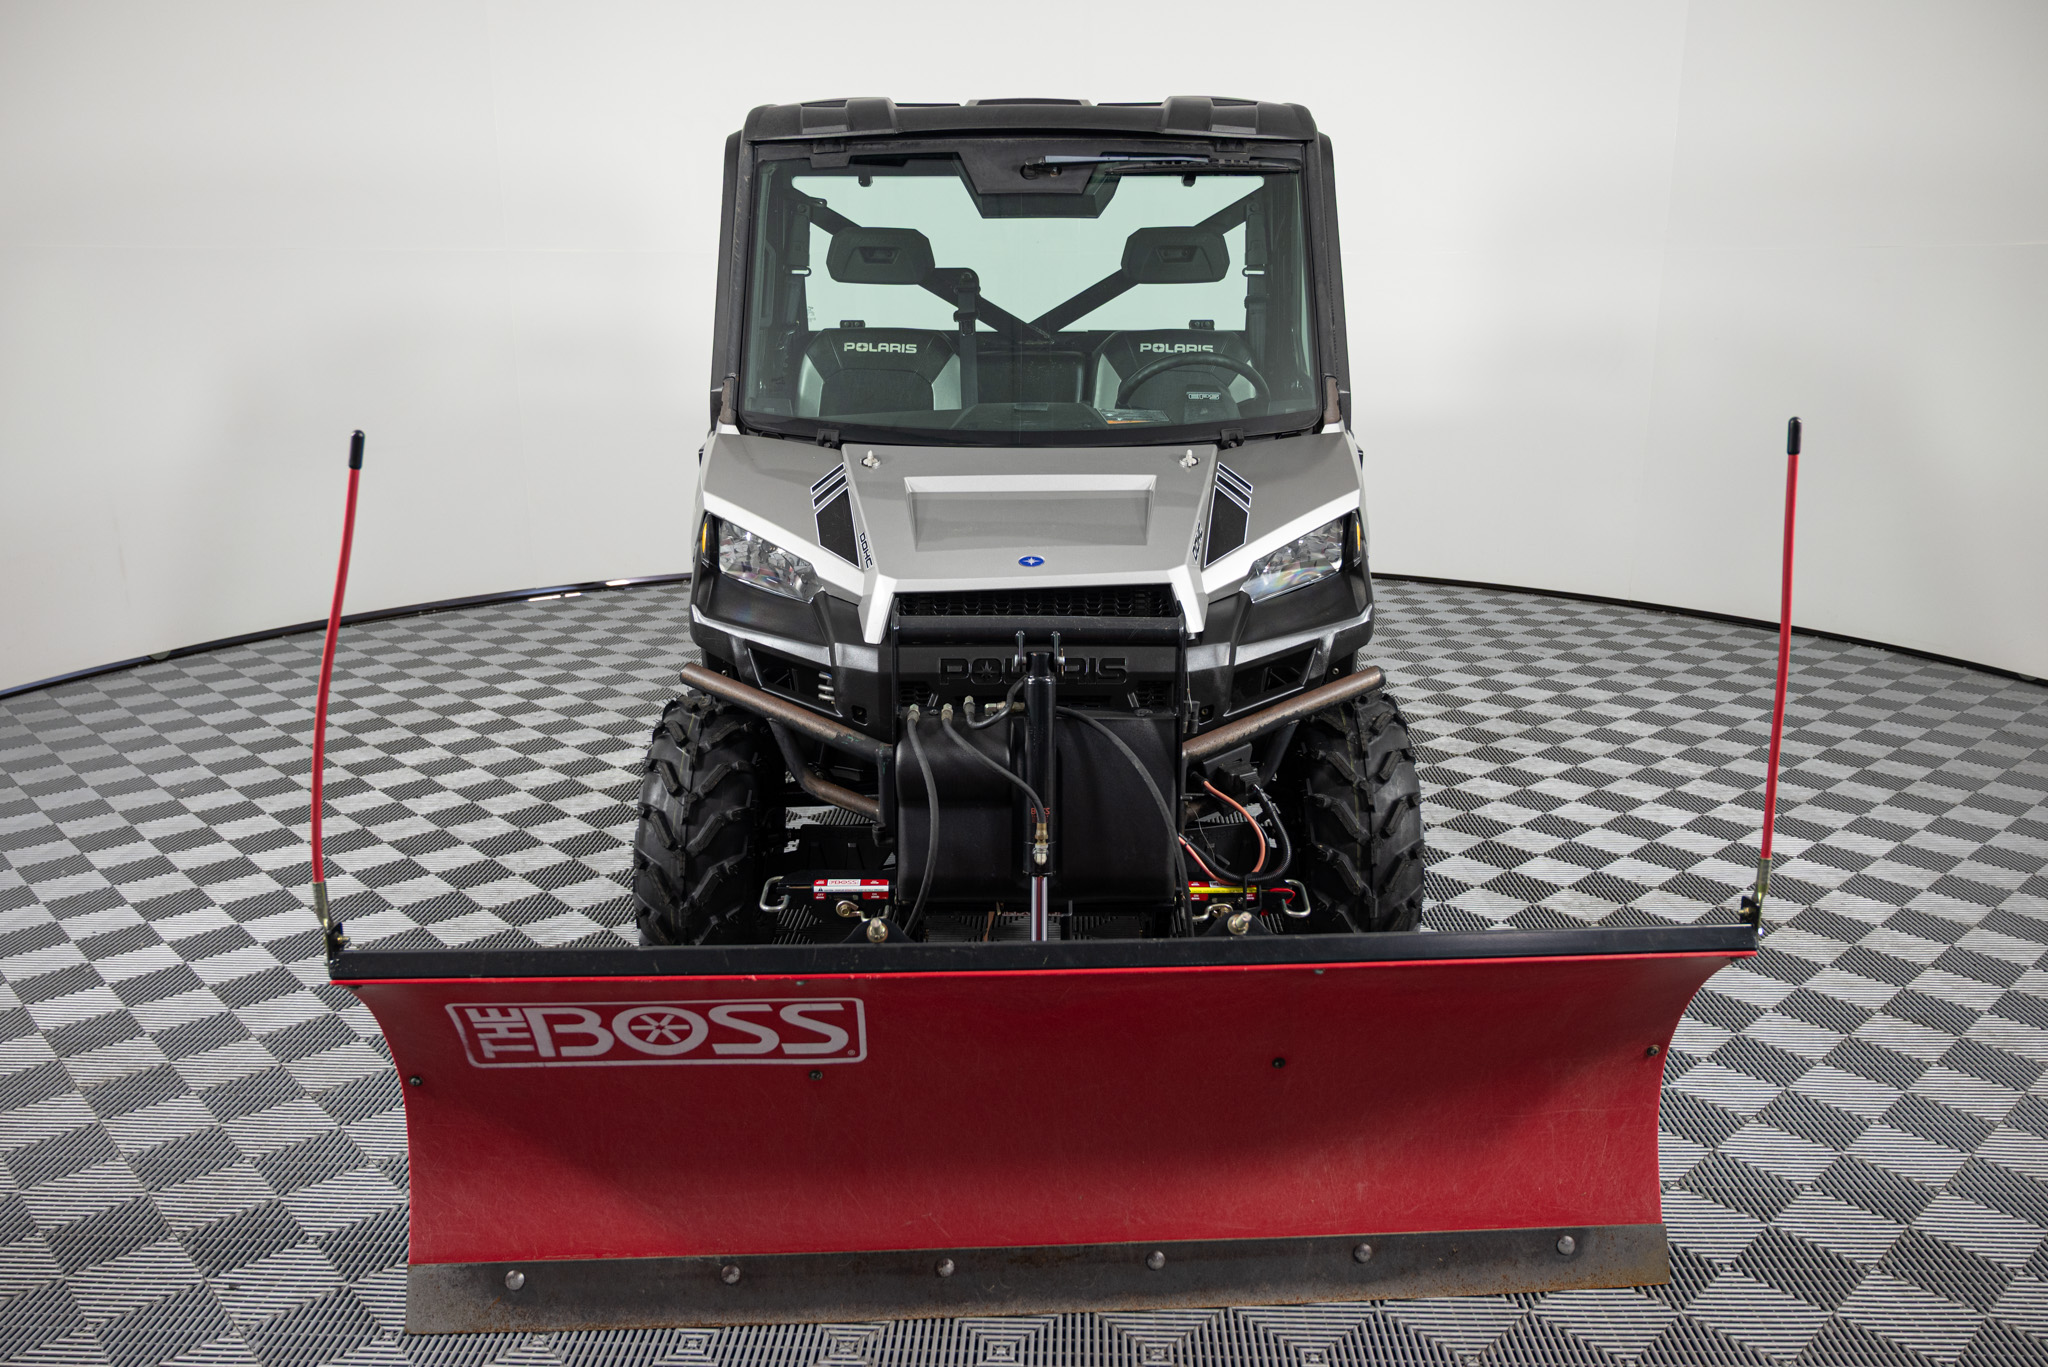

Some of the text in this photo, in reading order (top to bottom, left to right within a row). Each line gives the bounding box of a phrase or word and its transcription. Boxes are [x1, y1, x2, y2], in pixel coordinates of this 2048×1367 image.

[843, 342, 918, 354] POLARIS
[1139, 343, 1214, 354] POLARIS
[859, 531, 874, 569] DOHC
[939, 658, 1127, 684] POLRIS
[1030, 807, 1051, 815] BS
[465, 1003, 850, 1059] THE BOSS
